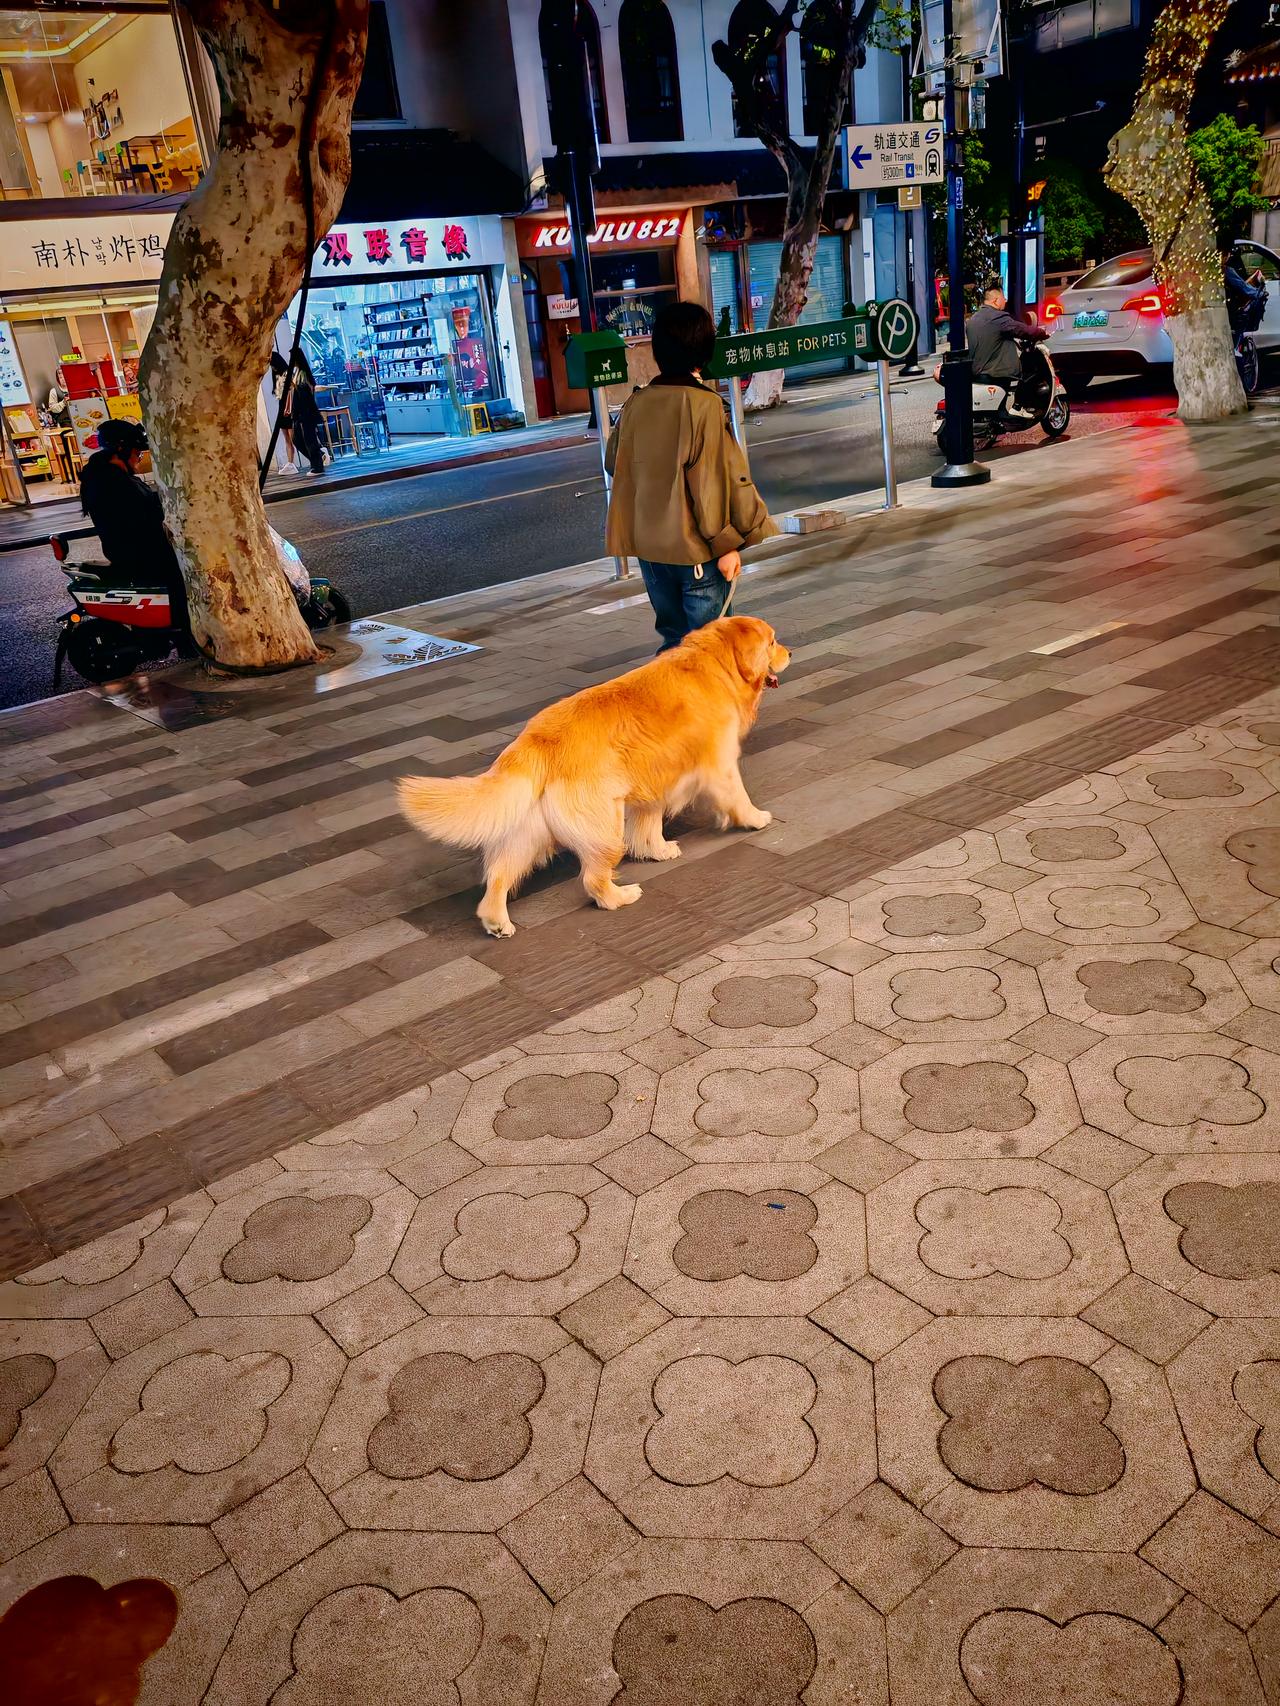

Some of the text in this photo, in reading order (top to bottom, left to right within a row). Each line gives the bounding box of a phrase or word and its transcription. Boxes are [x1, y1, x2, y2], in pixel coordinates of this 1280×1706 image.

[874, 130, 920, 150] 轨道交通
[880, 152, 915, 162] Rail Transit
[636, 218, 680, 239] 852
[31, 237, 90, 269] 南朴
[109, 233, 166, 263] 炸鸡
[325, 224, 470, 263] 双联音像
[797, 331, 847, 352] FOR PETS
[725, 341, 790, 366] 宠物休息站
